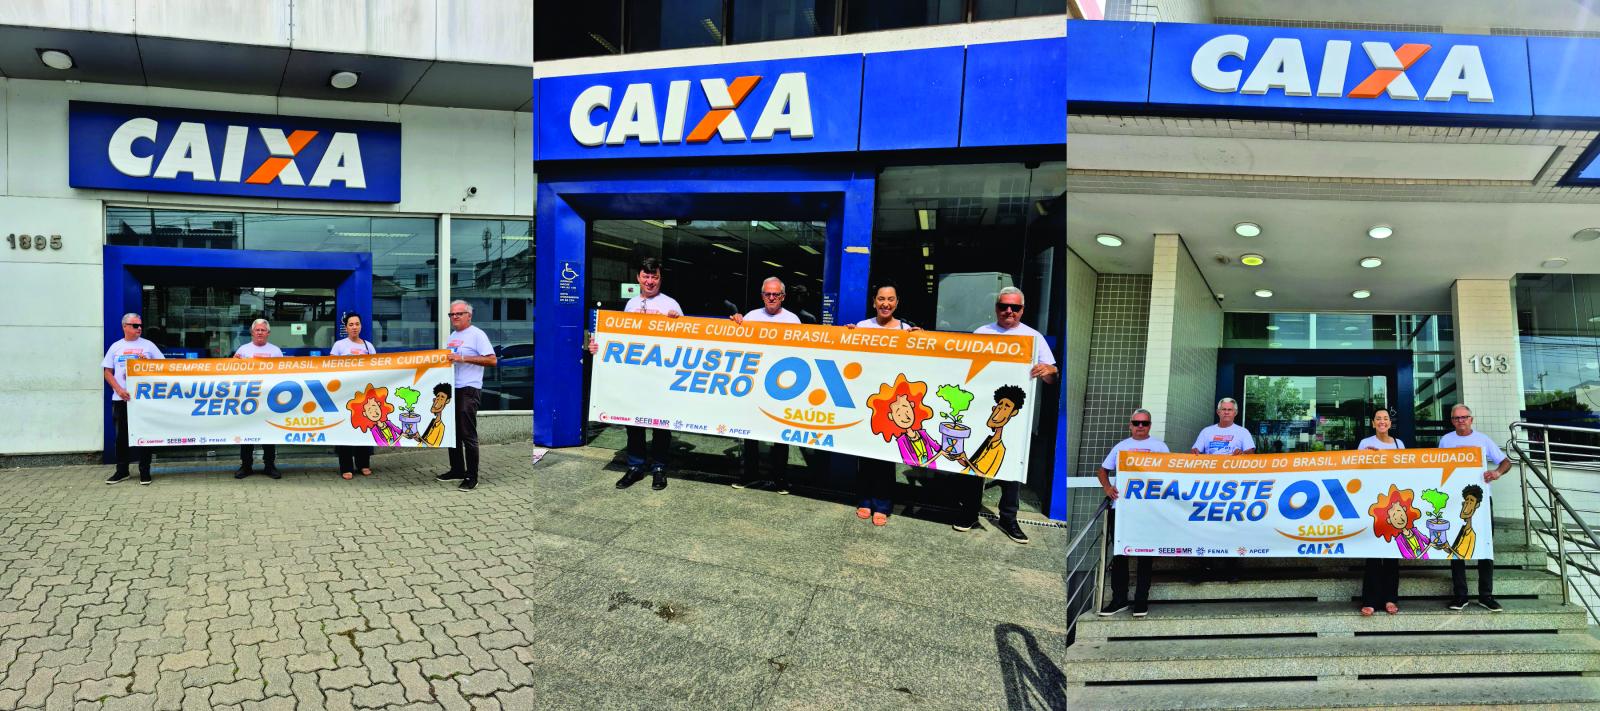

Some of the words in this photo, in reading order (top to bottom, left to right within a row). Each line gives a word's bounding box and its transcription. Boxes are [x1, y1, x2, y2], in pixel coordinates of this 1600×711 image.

[1190, 34, 1495, 103] CAIXA
[569, 71, 814, 147] CAIXA
[108, 117, 367, 189] CAIXA
[605, 316, 643, 330] QUEM
[648, 320, 700, 334] SEMPRE
[706, 324, 754, 338] CUIDOU
[759, 327, 778, 340] DO
[784, 330, 835, 345] BRASIL,
[840, 333, 900, 348] MERECE
[906, 336, 937, 350] SER
[944, 338, 1025, 357] CUIDADO.
[134, 363, 164, 372] QUEM
[169, 362, 211, 372] SEMPRE
[216, 362, 254, 371] CUIDOU
[259, 361, 274, 370] DO
[278, 360, 318, 370] BRASIL,
[322, 358, 363, 368] MERECE
[370, 356, 392, 366] SER
[602, 340, 764, 375] REAJUSTE
[1468, 354, 1509, 374] 193
[135, 380, 264, 400] REAJUSTE
[669, 369, 754, 398] ZERO
[191, 397, 260, 416] ZERO
[784, 407, 836, 425] SAÚDE
[285, 432, 326, 443] CAIXA
[781, 428, 834, 448] CAIXA
[1126, 456, 1162, 468] QUEM
[1168, 458, 1218, 469] SEMPRE
[1222, 459, 1268, 469] CUIDOU
[1272, 458, 1288, 468] DO
[1293, 456, 1337, 468] BRASIL,
[1341, 454, 1388, 465] MERECE
[1393, 453, 1416, 464] SER
[1421, 452, 1478, 463] CUIDADO.
[1124, 478, 1276, 501] REAJUSTE
[1188, 500, 1268, 522] ZERO
[1298, 522, 1344, 536] SAÚDE
[1297, 542, 1345, 554] CAIXA
